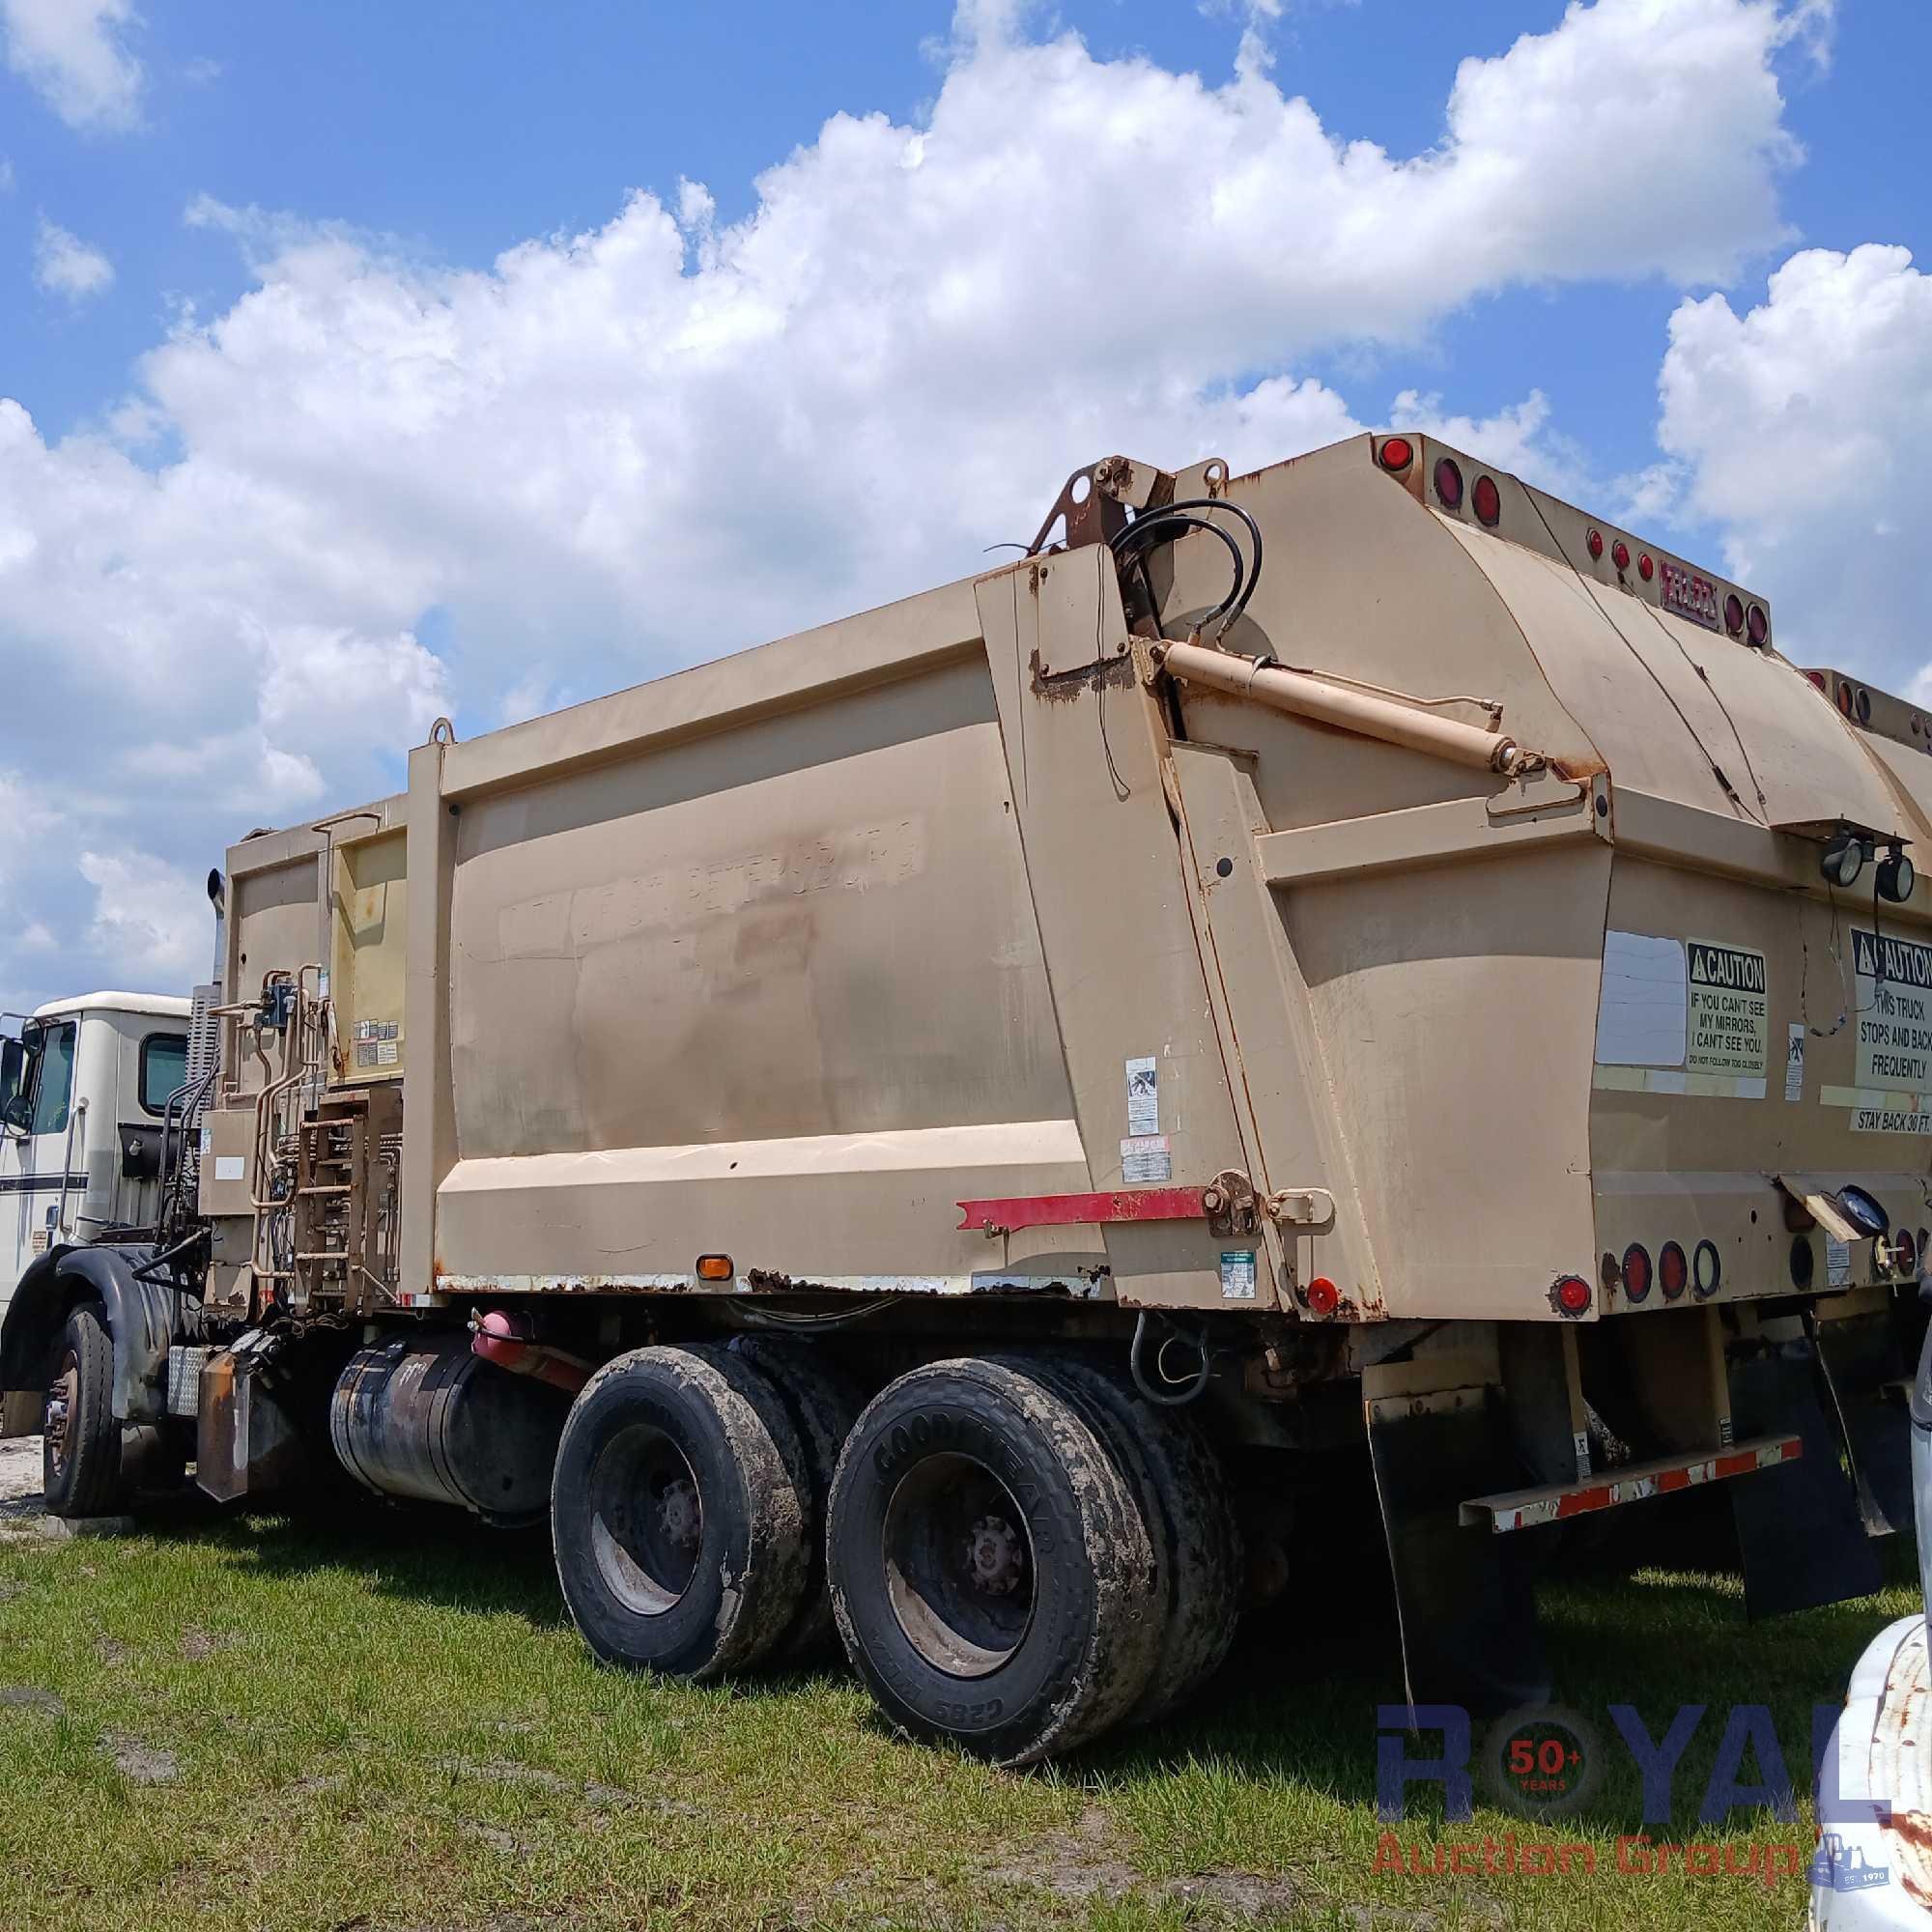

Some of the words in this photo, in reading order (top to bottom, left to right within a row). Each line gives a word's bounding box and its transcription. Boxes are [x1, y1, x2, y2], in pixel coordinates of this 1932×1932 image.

[1707, 951, 1764, 991] CAUTION
[1690, 991, 1699, 1008] IF
[1701, 993, 1719, 1009] YOU
[1748, 1001, 1765, 1016] SEE
[1896, 996, 1925, 1021] TRUCK
[1700, 1012, 1714, 1029] MY
[1715, 1015, 1757, 1037] MIRRORS,
[1861, 1020, 1889, 1045] STOPS
[1891, 1026, 1910, 1048] AND
[1724, 1036, 1742, 1051] SEE
[1744, 1037, 1763, 1054] YOU.
[1871, 1054, 1927, 1079] FREQUENTLY
[1858, 1111, 1882, 1130] STAY
[1882, 1112, 1907, 1131] BACK
[1918, 1115, 1930, 1133] FT.
